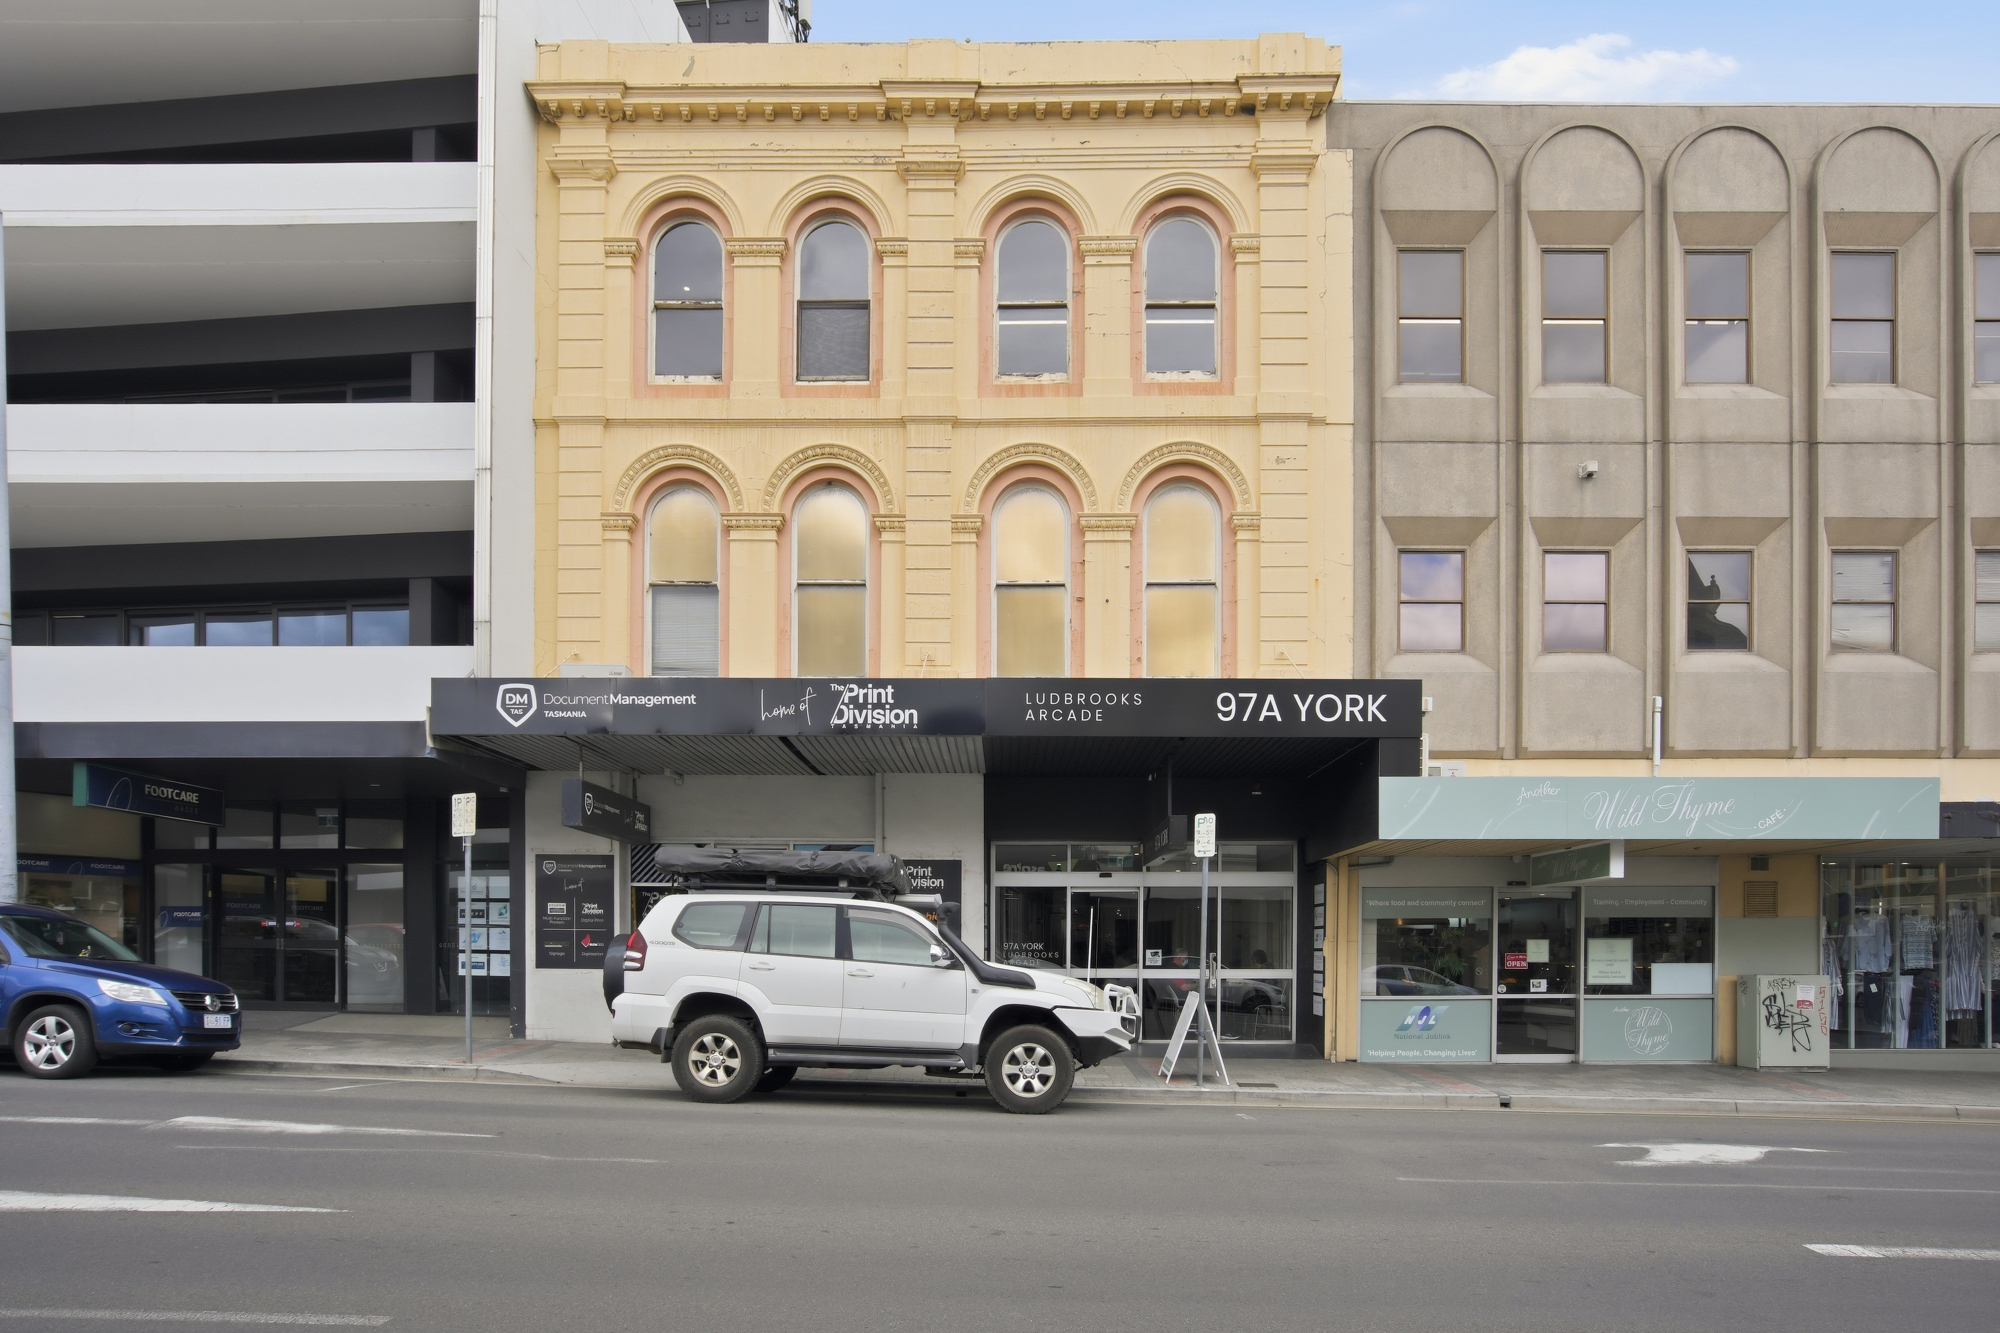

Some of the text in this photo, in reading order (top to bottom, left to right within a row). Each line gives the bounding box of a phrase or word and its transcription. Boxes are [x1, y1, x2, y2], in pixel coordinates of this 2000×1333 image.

[829, 683, 845, 692] The
[843, 683, 895, 704] Print
[505, 693, 528, 705] DM
[760, 686, 818, 726] home of
[1025, 692, 1144, 706] LUDBROOKS
[543, 710, 587, 718] TASMANIA
[830, 704, 919, 725] Division
[1216, 692, 1388, 723] 97A YORK
[1025, 708, 1104, 722] ARCADE
[144, 784, 200, 804] FOOTCARE
[1516, 779, 1736, 838] Another Wild Thyme
[1592, 898, 1708, 906] Training Employment Community
[1003, 942, 1045, 950] 97A YORK
[1003, 951, 1059, 959] LUDBROOKS
[1630, 1006, 1664, 1028] Wild
[1627, 1028, 1669, 1054] Thyme
[1423, 1049, 1457, 1058] Changing
